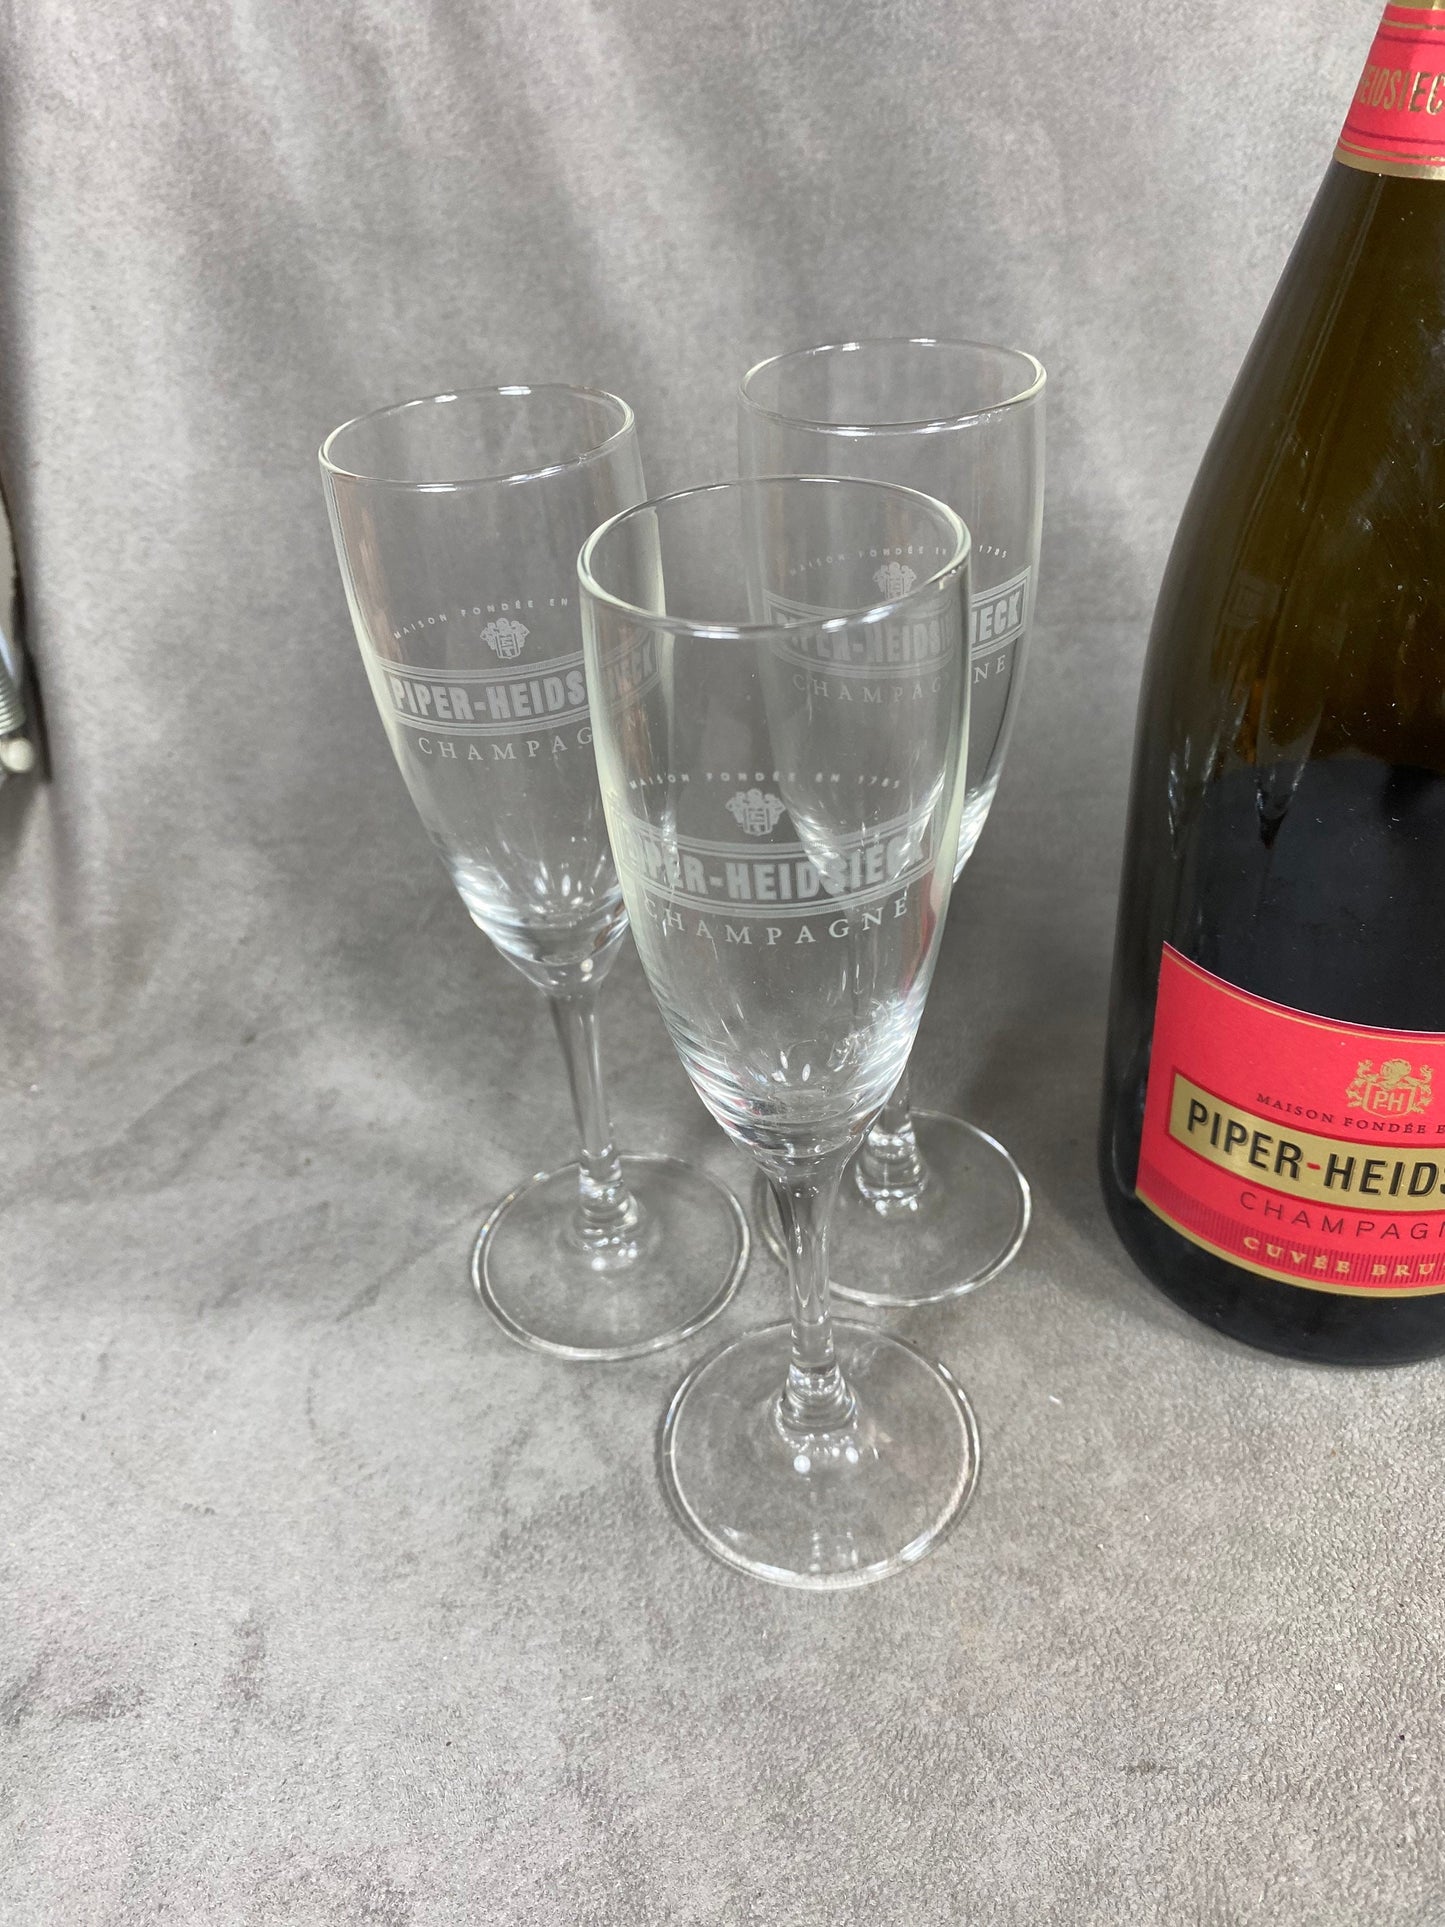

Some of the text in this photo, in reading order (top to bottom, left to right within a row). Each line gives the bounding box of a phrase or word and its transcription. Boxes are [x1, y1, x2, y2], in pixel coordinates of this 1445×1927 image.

[1356, 65, 1445, 115] EIDSIEC
[393, 613, 448, 640] MAISON
[549, 598, 568, 607] EN
[629, 774, 690, 790] MAISON
[815, 772, 840, 783] EN
[1256, 1092, 1335, 1124] MAISON
[1343, 1116, 1427, 1135] FONDÉE
[1239, 1190, 1445, 1241] CHAMPAG
[1243, 1235, 1445, 1278] CUVÉE BRU
